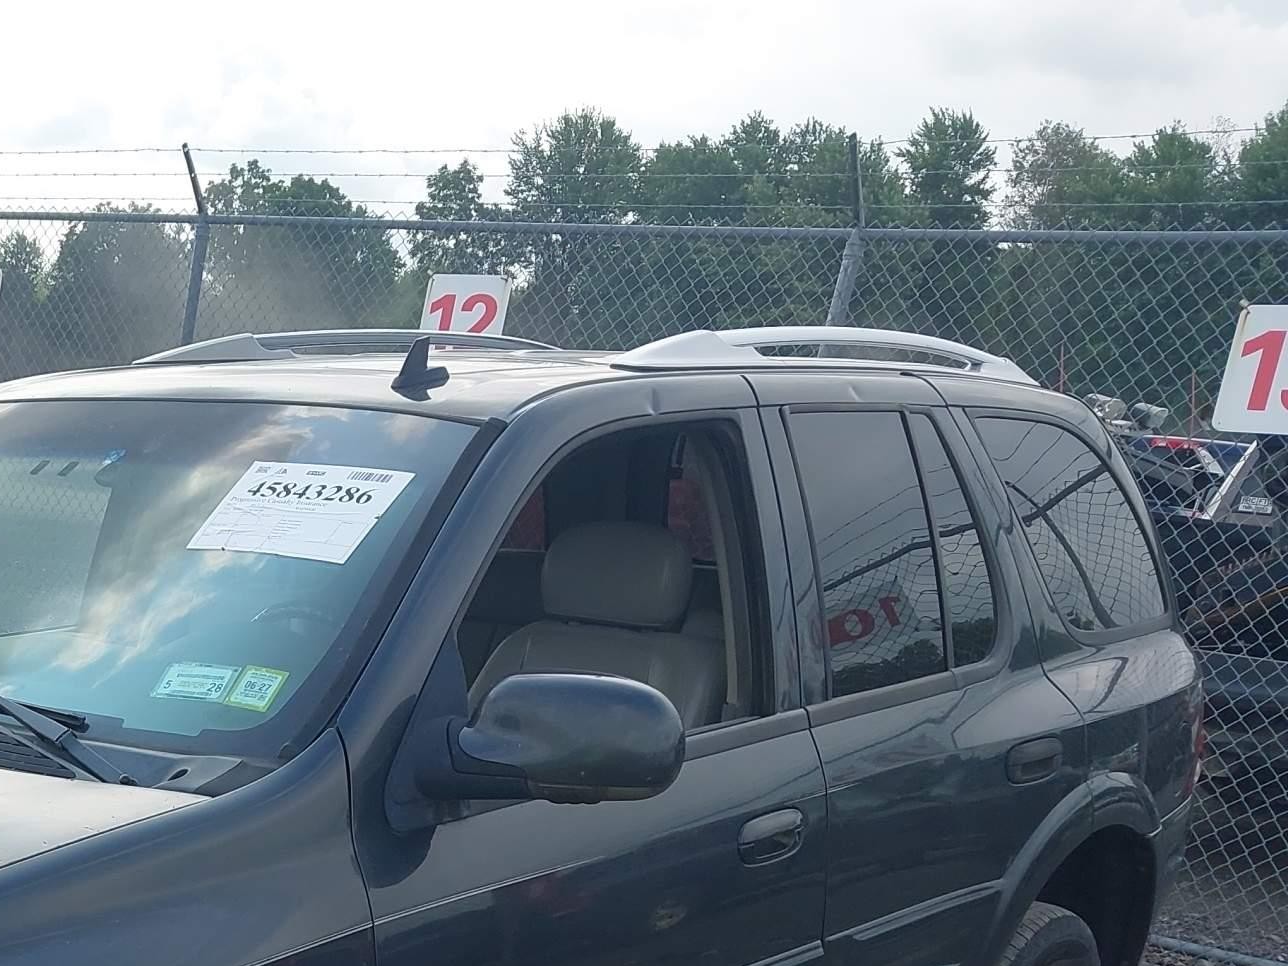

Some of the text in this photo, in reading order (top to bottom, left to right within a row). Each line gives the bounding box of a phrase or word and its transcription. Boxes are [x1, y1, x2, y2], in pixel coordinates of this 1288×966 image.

[429, 292, 499, 334] 12
[1240, 330, 1288, 413] 1
[247, 480, 382, 505] 45843286
[163, 680, 173, 689] 5
[206, 682, 224, 694] 28
